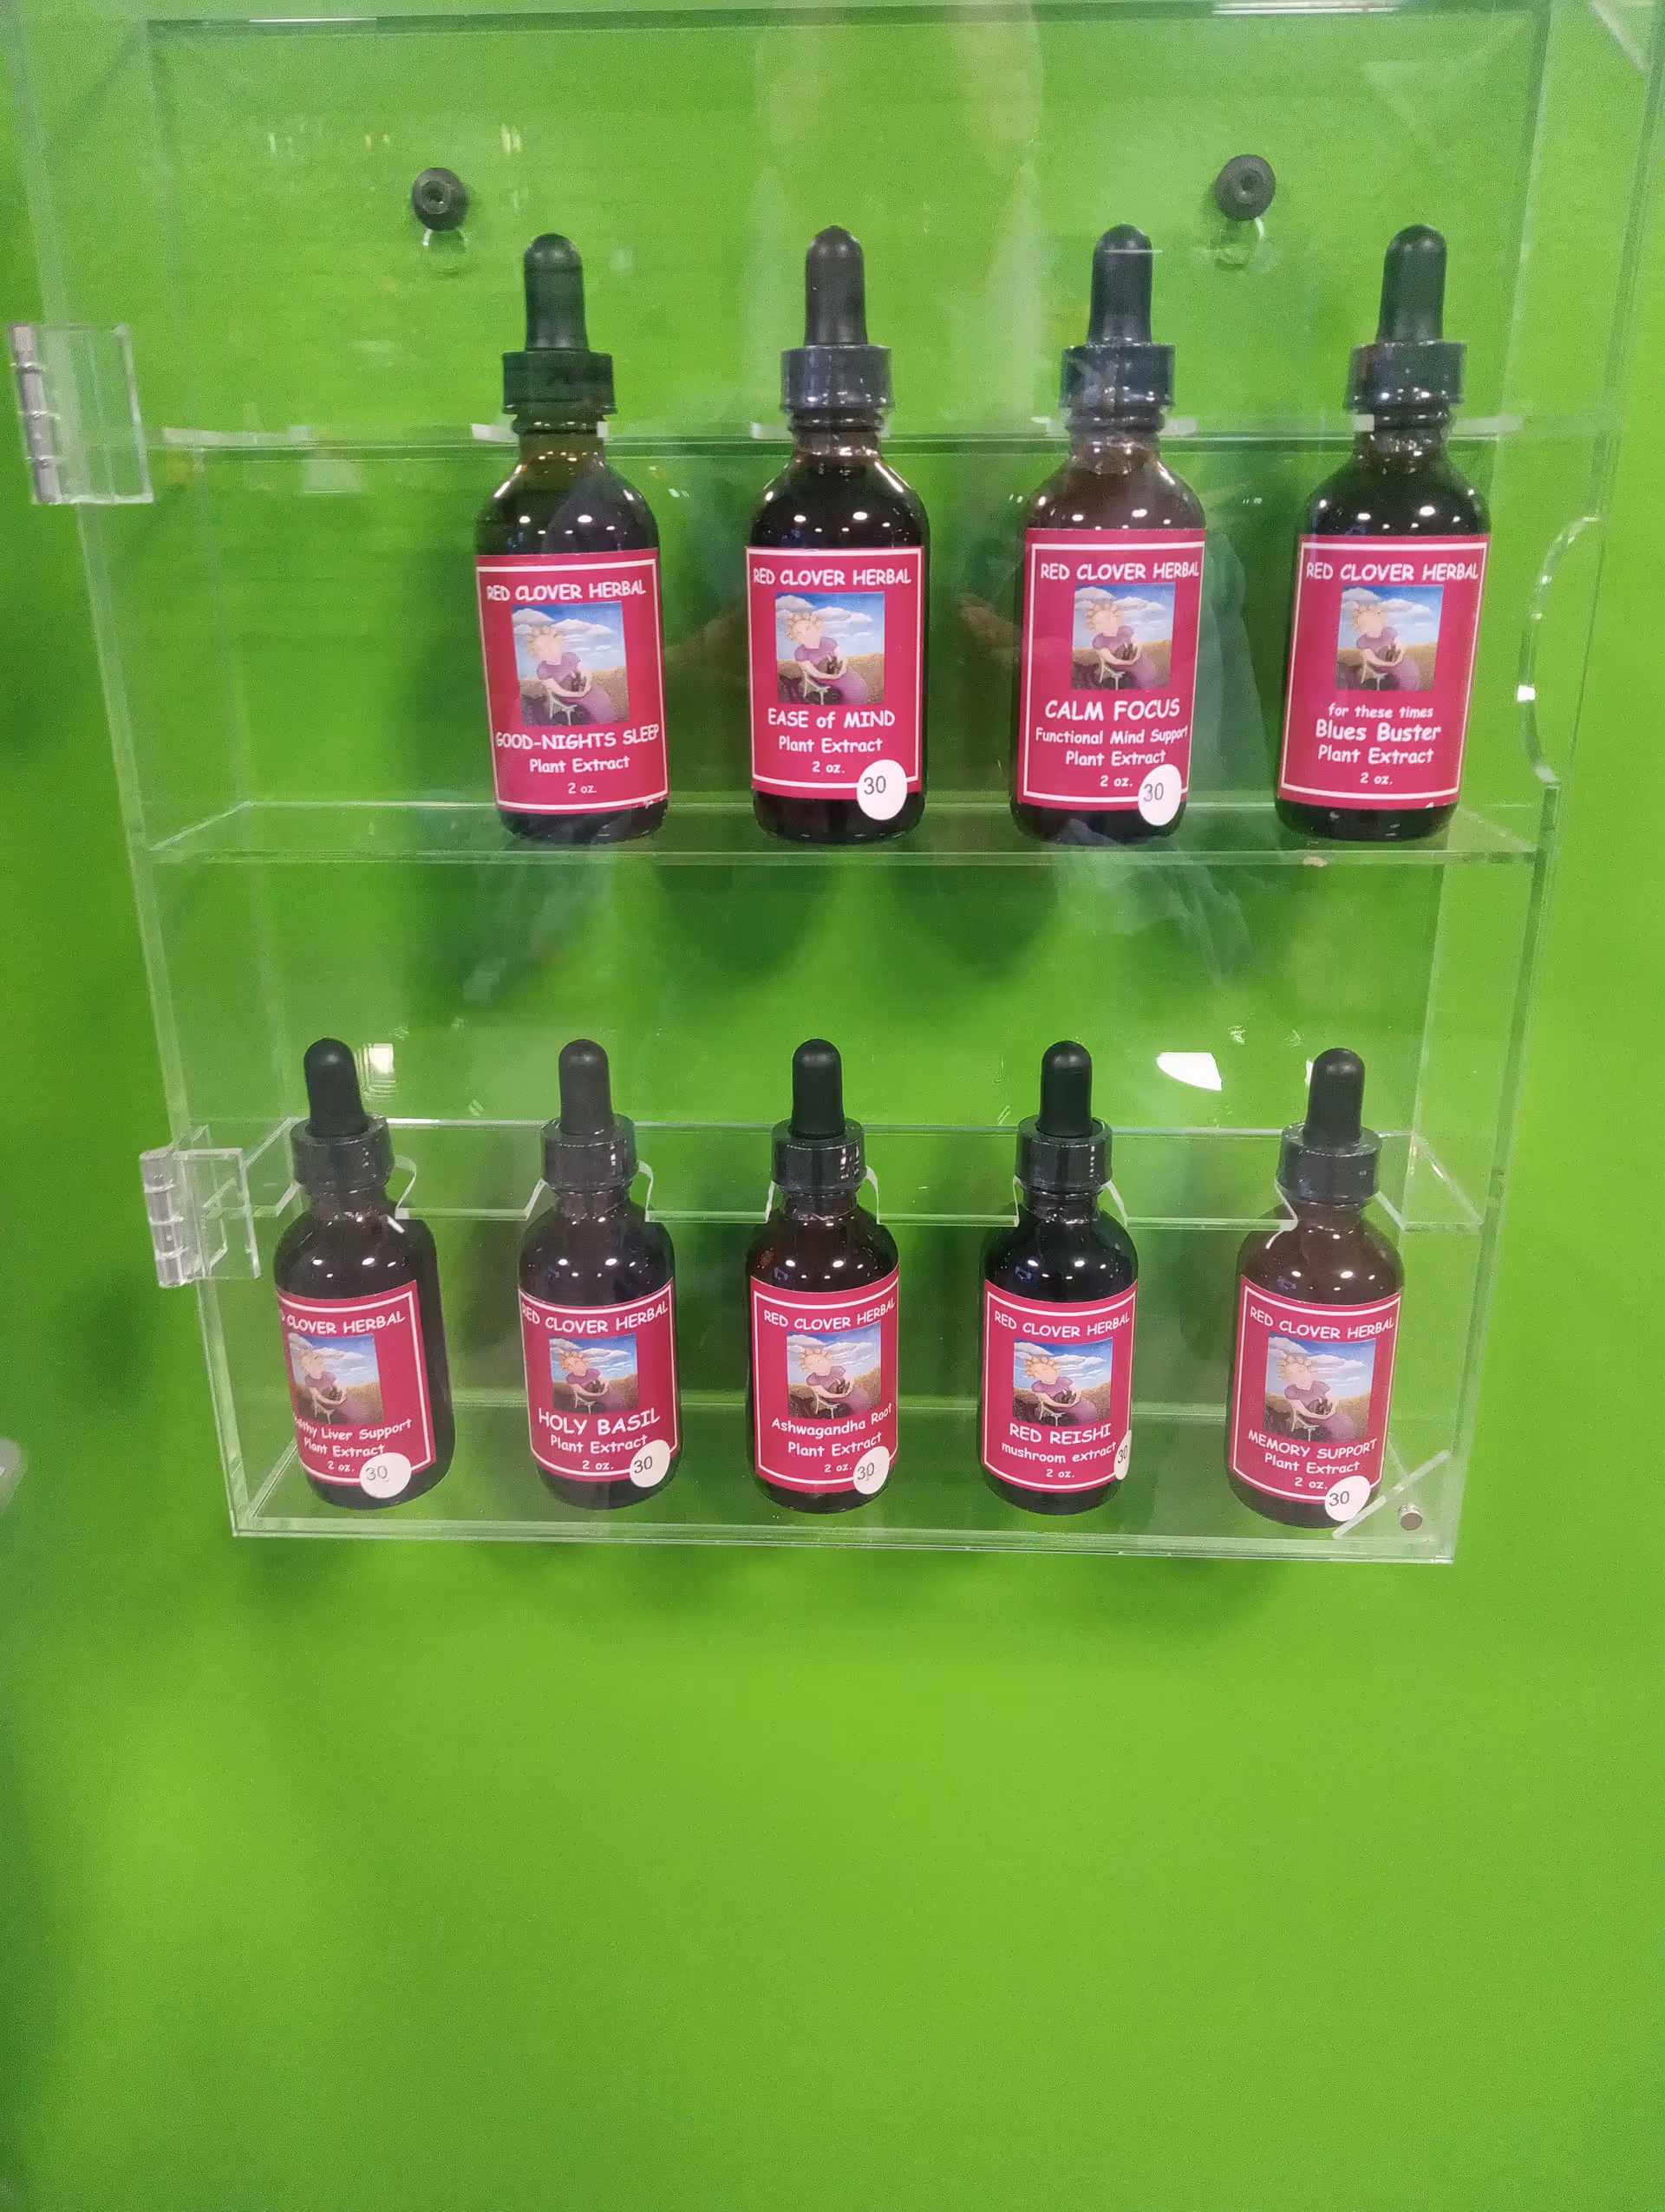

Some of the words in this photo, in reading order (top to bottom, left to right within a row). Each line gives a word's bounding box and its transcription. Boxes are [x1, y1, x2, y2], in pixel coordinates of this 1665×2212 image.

[753, 568, 775, 584] RED
[780, 569, 846, 586] CLOVER
[852, 568, 911, 585] HERBAL
[1041, 564, 1070, 580] RED
[1076, 564, 1146, 581] CLOVER
[1153, 562, 1199, 578] HERBAL
[1307, 562, 1333, 579] RED
[1340, 564, 1414, 582] CLOVER
[1422, 563, 1478, 581] HERBAL
[486, 585, 510, 601] RED
[515, 584, 583, 601] CLOVER
[589, 579, 646, 598] HERBAL
[767, 708, 809, 728] EASE
[816, 712, 835, 728] of
[844, 710, 896, 728] MIND
[1045, 701, 1104, 721] CALM
[1113, 699, 1180, 721] FOCUS
[1328, 702, 1349, 716] for
[1355, 706, 1393, 719] these
[1400, 706, 1433, 720] times
[496, 732, 617, 750] GOOD-NIGHTS
[623, 724, 659, 746] SLEEP
[1035, 728, 1103, 745] Functional
[1110, 730, 1145, 744] Mind
[1150, 725, 1188, 745] Support
[1316, 720, 1367, 741] Blues
[1377, 723, 1441, 742] Buster
[779, 736, 814, 753] Plant
[821, 738, 883, 754] Extract
[1318, 745, 1361, 763] Plant
[1368, 747, 1433, 765] Extract
[529, 758, 566, 773] Plant
[572, 755, 630, 773] Extract
[812, 761, 820, 773] 2
[1066, 751, 1105, 767] Plant
[1111, 749, 1166, 767] Extract
[567, 782, 577, 793] 2
[863, 776, 887, 795] 30
[1100, 776, 1109, 786] 2
[1360, 773, 1368, 784] 2
[1143, 783, 1165, 802] 30
[287, 1315, 336, 1335] CLOVER
[343, 1310, 406, 1334] HERBAL
[522, 1302, 540, 1325] RED
[545, 1317, 608, 1334] CLOVER
[616, 1301, 668, 1331] HERBAL
[764, 1310, 788, 1328] RED
[794, 1317, 851, 1330] CLOVER
[858, 1297, 895, 1325] HERBAL
[1250, 1306, 1273, 1327] RED
[1279, 1321, 1340, 1339] CLOVER
[1347, 1317, 1394, 1339] HERBAL
[995, 1310, 1017, 1330] RED
[1022, 1322, 1081, 1338] CLOVER
[1087, 1312, 1130, 1336] HERBAL
[321, 1426, 353, 1441] Liver
[359, 1419, 412, 1440] Support
[539, 1407, 587, 1436] HOLY
[597, 1408, 661, 1435] BASIL
[772, 1418, 866, 1439] Ashwagandha
[871, 1402, 893, 1426] Root
[551, 1435, 584, 1453] Plant
[591, 1434, 648, 1454] Extract
[1009, 1423, 1041, 1443] RED
[1050, 1423, 1112, 1445] REISHI
[1248, 1429, 1310, 1458] MEMORY
[1316, 1439, 1377, 1459] SUPPORT
[304, 1436, 328, 1456] Plant
[333, 1445, 385, 1458] Extract
[788, 1441, 825, 1458] Plant
[832, 1432, 882, 1457] Extract
[1002, 1443, 1066, 1464] mushroom
[1072, 1441, 1118, 1462] extract
[1118, 1445, 1127, 1464] 30
[328, 1461, 335, 1470] 2
[365, 1465, 388, 1481] 30
[582, 1460, 590, 1470] 2
[633, 1456, 653, 1473] 30
[825, 1464, 831, 1472] 2
[857, 1463, 874, 1480] 30
[1046, 1469, 1053, 1478] 2
[1264, 1453, 1300, 1471] Plant
[1306, 1461, 1360, 1474] Extract
[1295, 1478, 1303, 1486] 2
[1329, 1491, 1349, 1506] 30
